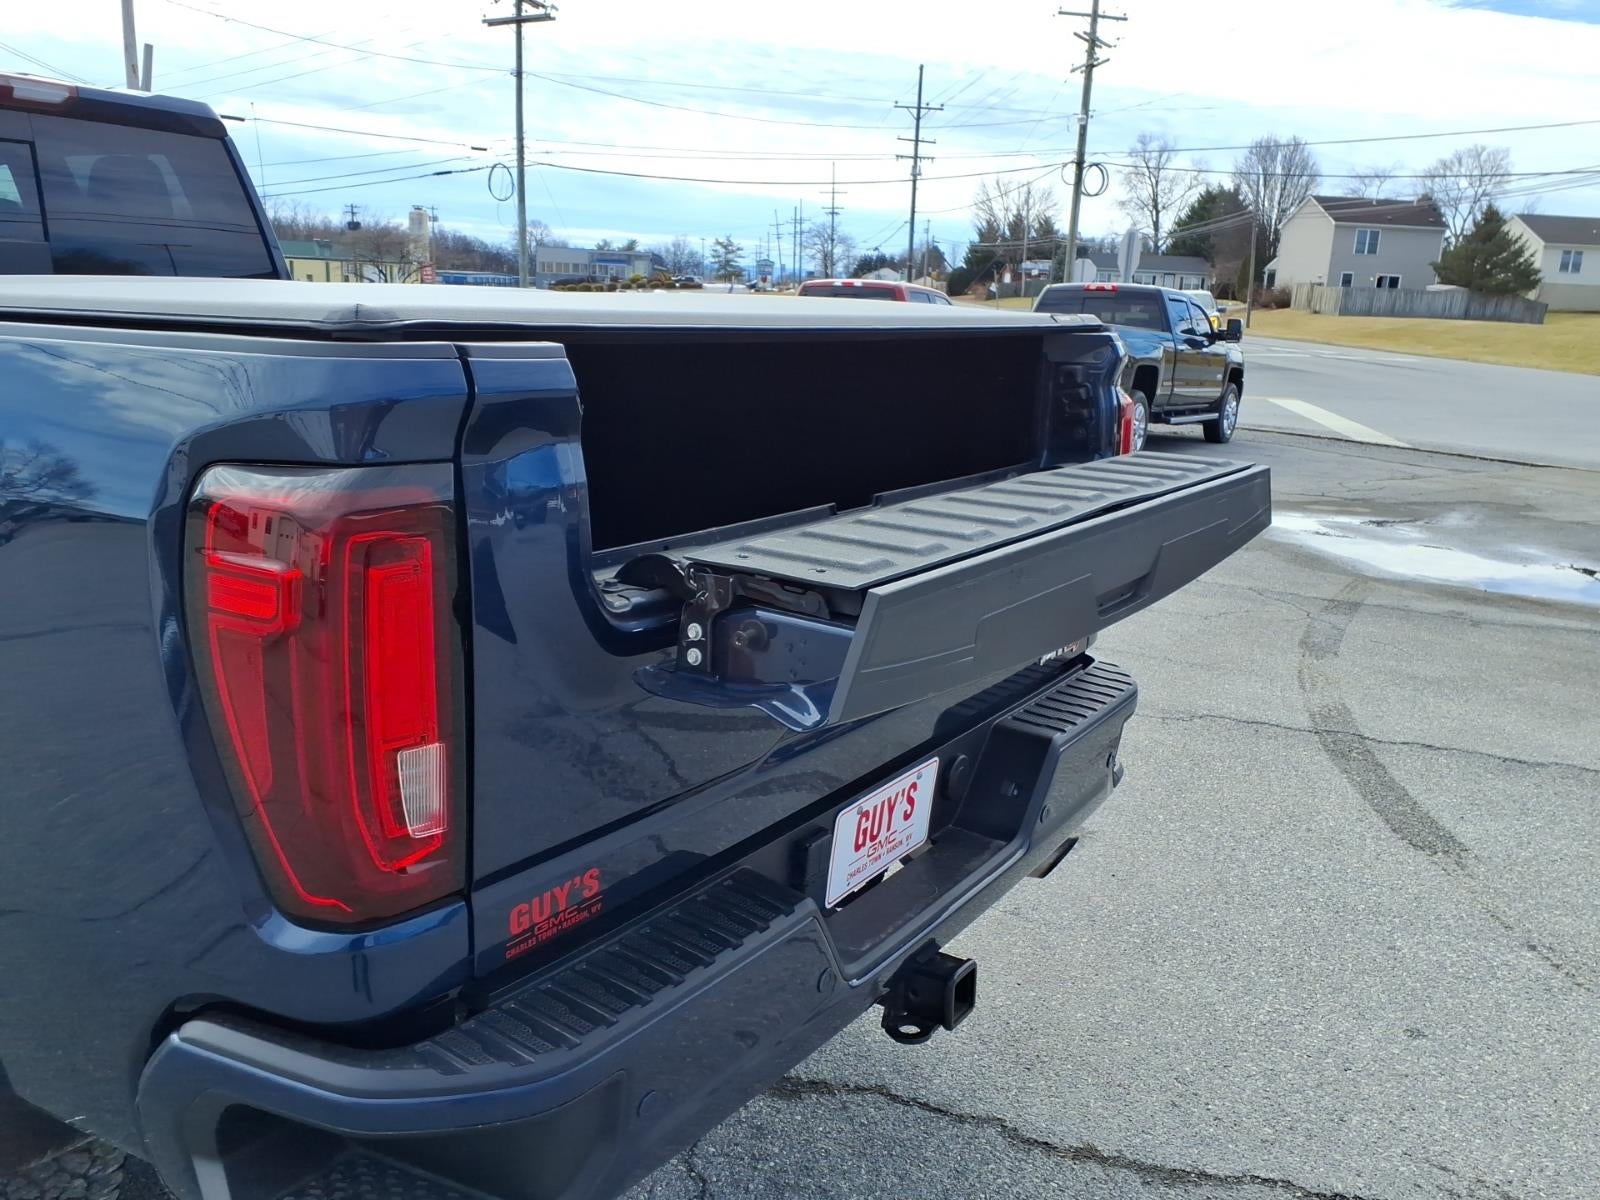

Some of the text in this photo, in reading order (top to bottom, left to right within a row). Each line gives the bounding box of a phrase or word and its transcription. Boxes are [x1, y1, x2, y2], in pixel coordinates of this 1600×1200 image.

[853, 780, 919, 853] GUY'S
[866, 829, 898, 858] GMC
[509, 867, 601, 936] GUY'S
[534, 905, 579, 936] GMC
